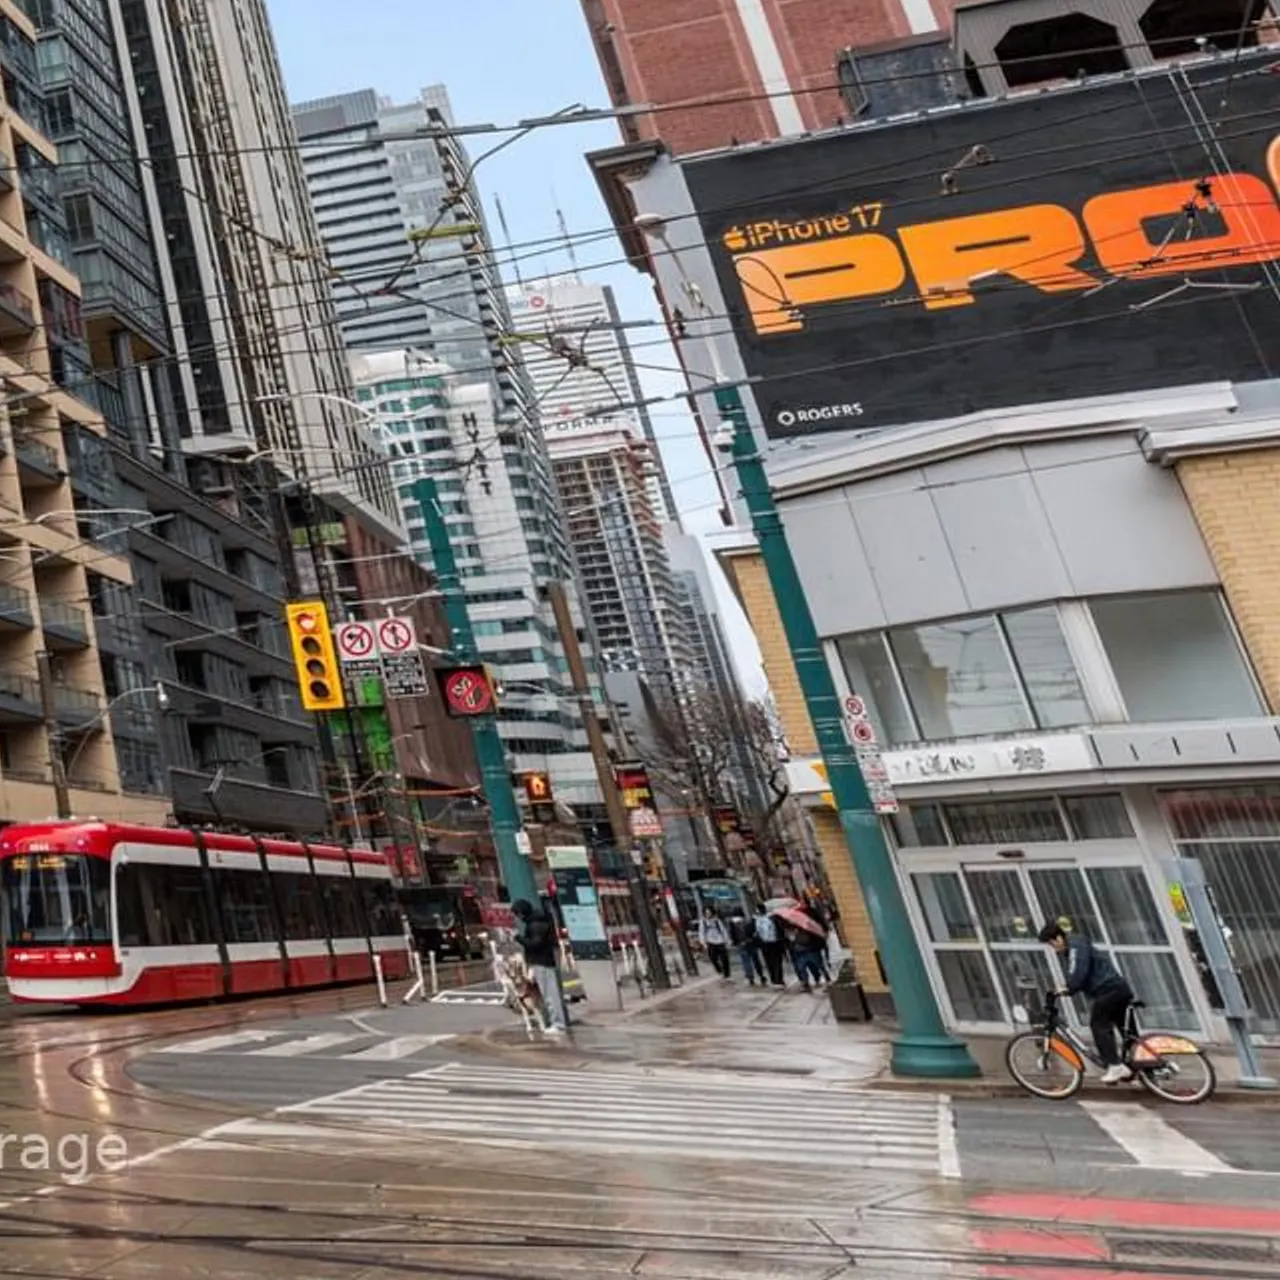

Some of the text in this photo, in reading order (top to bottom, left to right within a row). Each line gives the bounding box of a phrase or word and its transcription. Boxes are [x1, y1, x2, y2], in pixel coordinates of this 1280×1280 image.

[732, 172, 1280, 336] PRO
[746, 202, 883, 247] iPhone 17
[797, 401, 864, 422] ROGERS
[461, 412, 492, 496] HYATT
